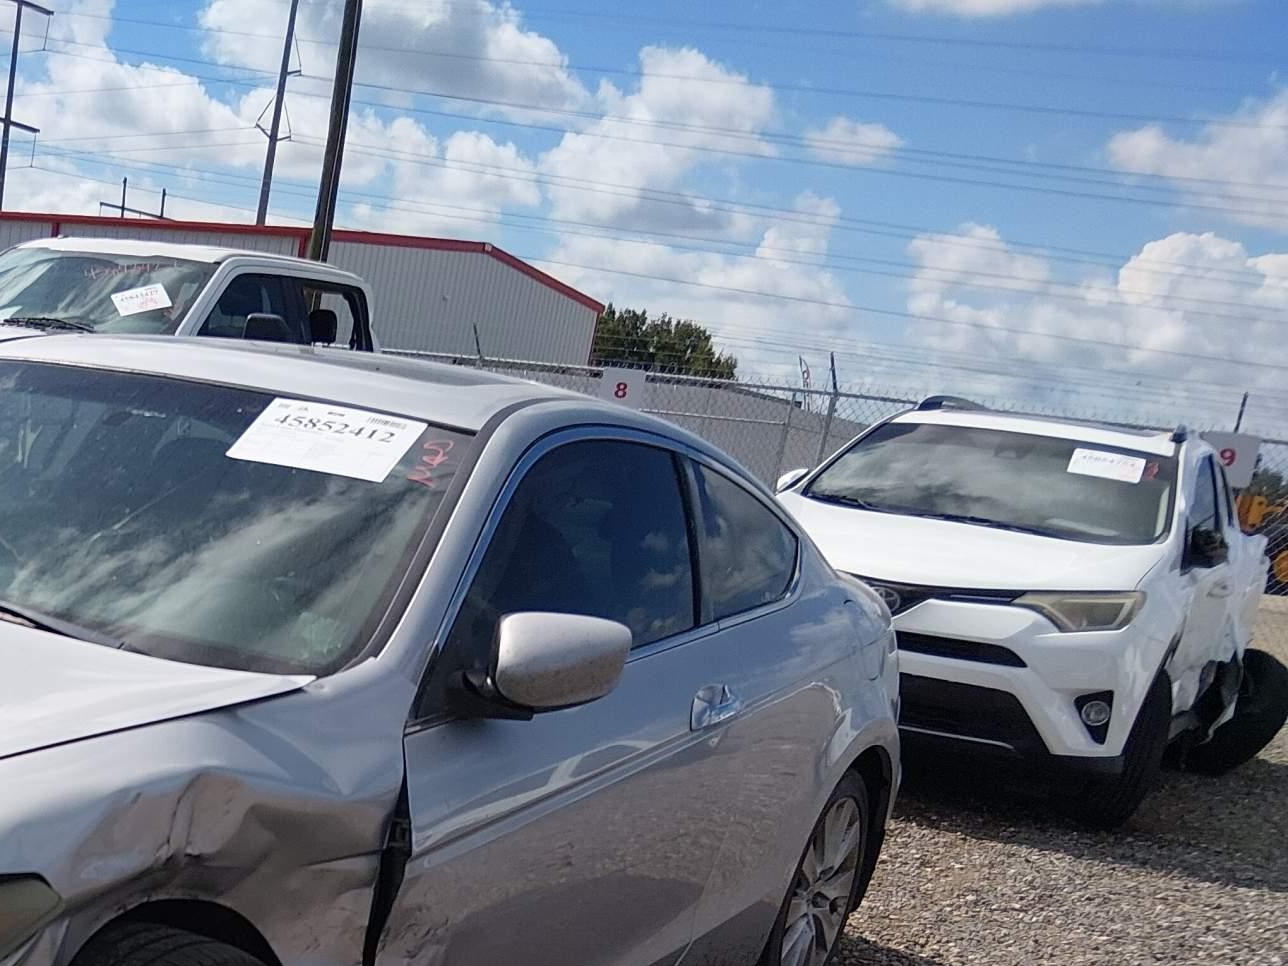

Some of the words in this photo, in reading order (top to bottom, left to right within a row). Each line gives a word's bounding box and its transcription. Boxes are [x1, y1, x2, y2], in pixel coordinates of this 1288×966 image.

[614, 382, 628, 399] 8
[274, 414, 395, 443] 45852412
[1220, 448, 1236, 467] 9
